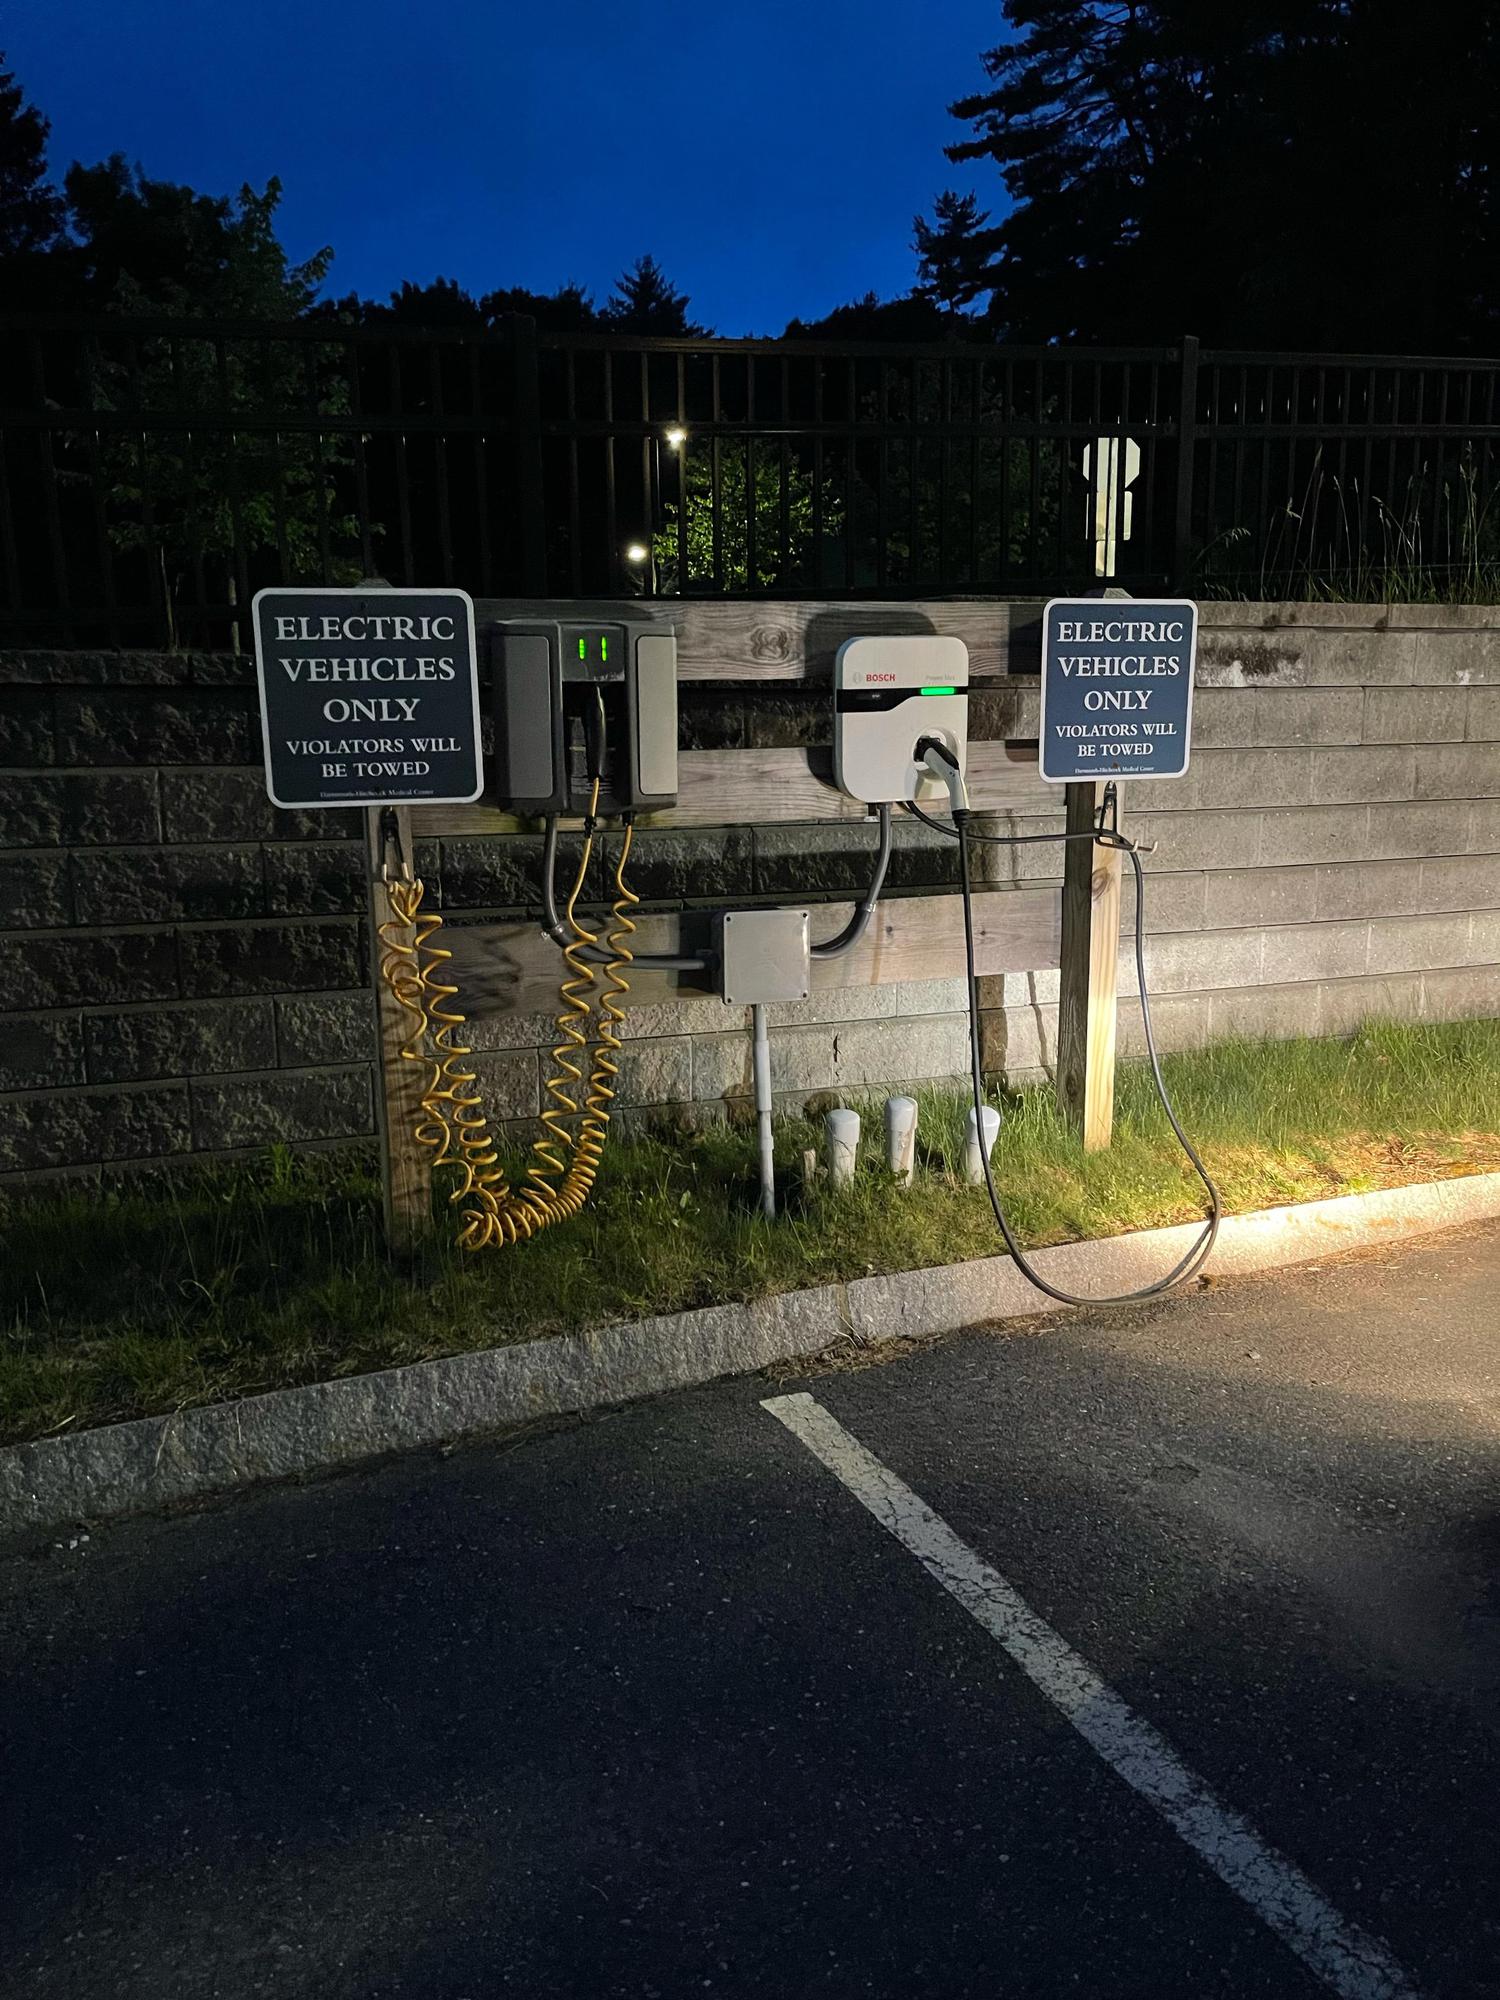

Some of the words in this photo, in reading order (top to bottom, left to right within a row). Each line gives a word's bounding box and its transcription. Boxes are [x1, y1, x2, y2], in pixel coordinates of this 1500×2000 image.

[274, 616, 455, 641] ELECTRIC
[1057, 622, 1183, 642] ELECTRIC
[278, 657, 456, 682] VEHICLES
[1058, 656, 1180, 677] VEHICLES
[865, 673, 896, 682] BOSCH
[323, 698, 421, 723] ONLY
[1084, 690, 1153, 711] ONLY
[1056, 724, 1138, 738] VIOLATORS
[1142, 723, 1177, 736] WILL
[286, 738, 404, 755] VIOLATORS
[410, 737, 461, 752] WILL
[1077, 744, 1096, 757] BE
[1099, 743, 1154, 756] TOWED
[322, 763, 347, 778] BE
[353, 761, 430, 777] TOWED
